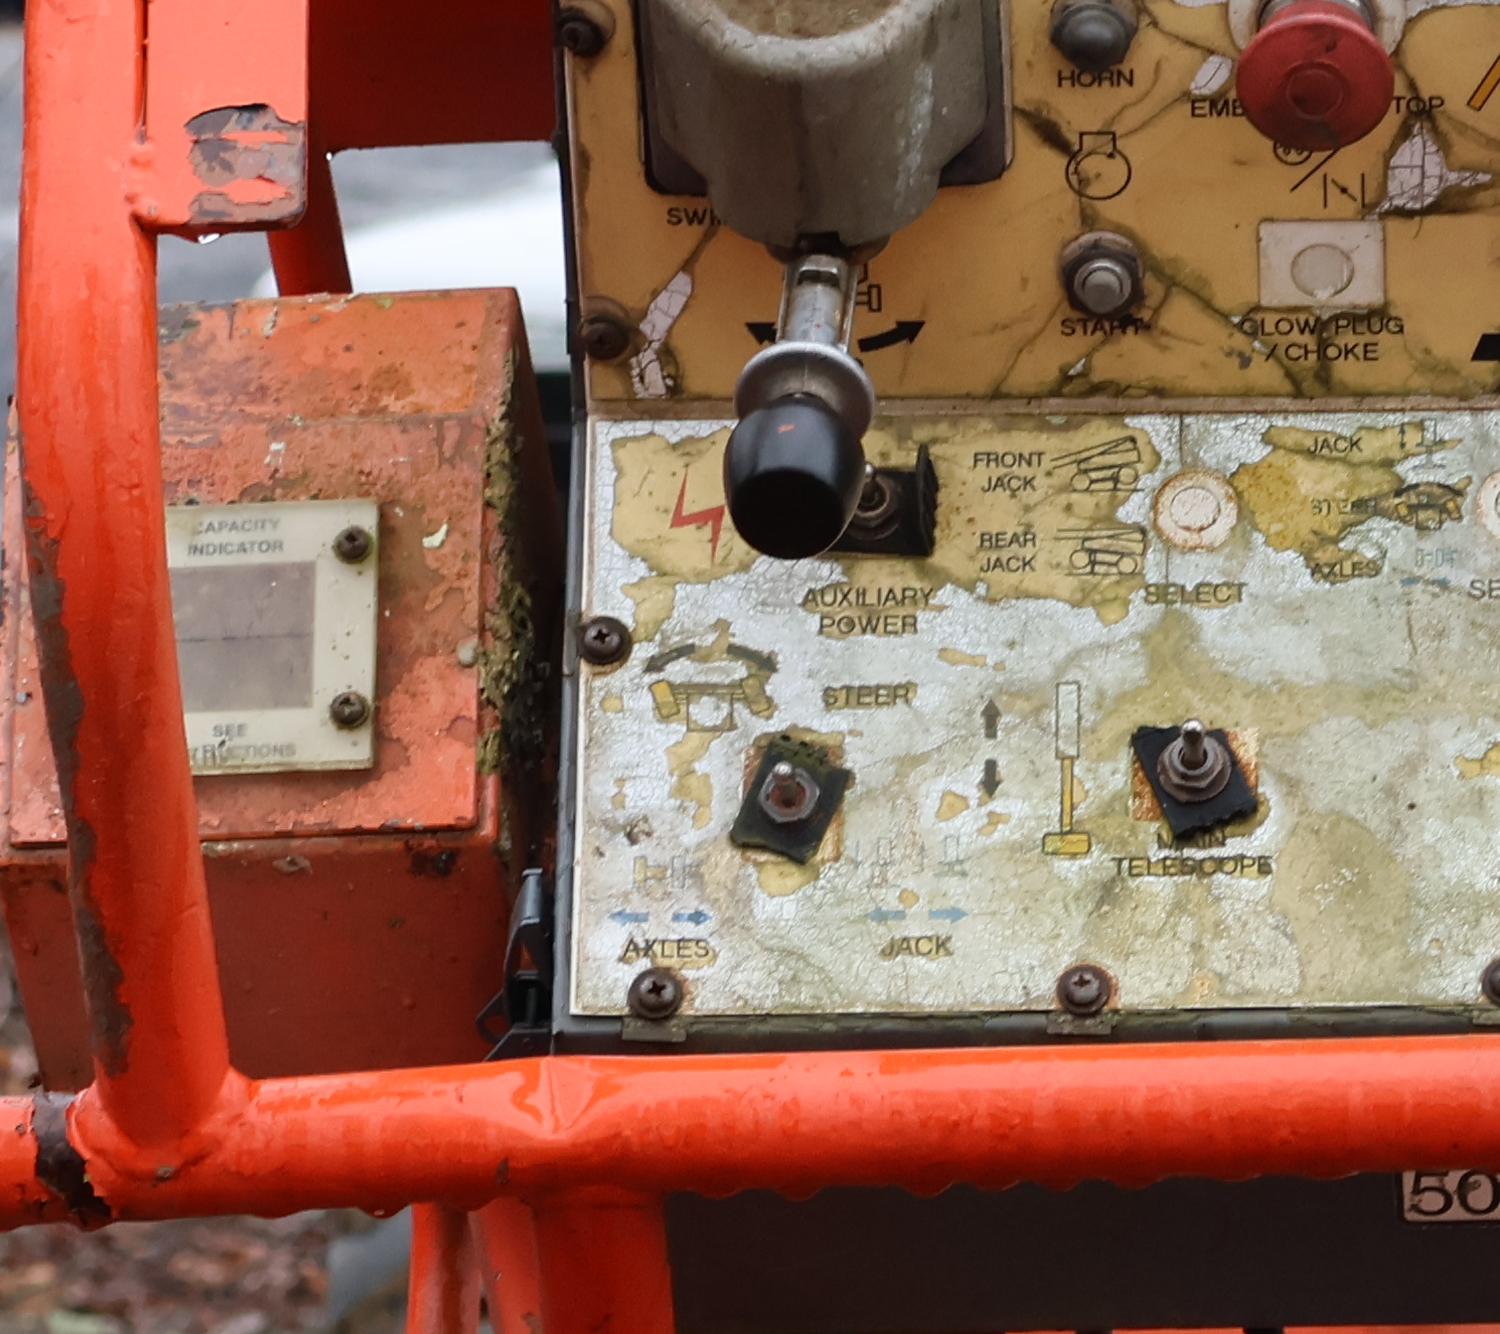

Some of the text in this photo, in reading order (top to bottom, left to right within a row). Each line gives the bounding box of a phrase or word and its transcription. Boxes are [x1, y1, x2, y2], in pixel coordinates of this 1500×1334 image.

[1057, 68, 1134, 87] HORN
[1391, 96, 1445, 115] TOP
[665, 207, 724, 226] SWI
[1060, 317, 1144, 336] START
[1241, 316, 1405, 336] GLOW PLUG
[1309, 437, 1363, 454] JACK
[973, 451, 1046, 469] FRONT
[981, 475, 1038, 493] JACK
[187, 539, 285, 556] INDICATOR
[979, 532, 1037, 549] REAR
[979, 555, 1037, 573] JACK
[1311, 560, 1380, 579] AXLES
[801, 587, 935, 607] AUXILIARY
[1144, 583, 1249, 604] SELECT
[819, 615, 919, 635] POWER
[822, 684, 912, 707] STEER
[212, 723, 248, 739] SEE
[1112, 856, 1274, 877] TELESCOPE
[621, 937, 711, 960] AXLES
[881, 935, 954, 957] JACK
